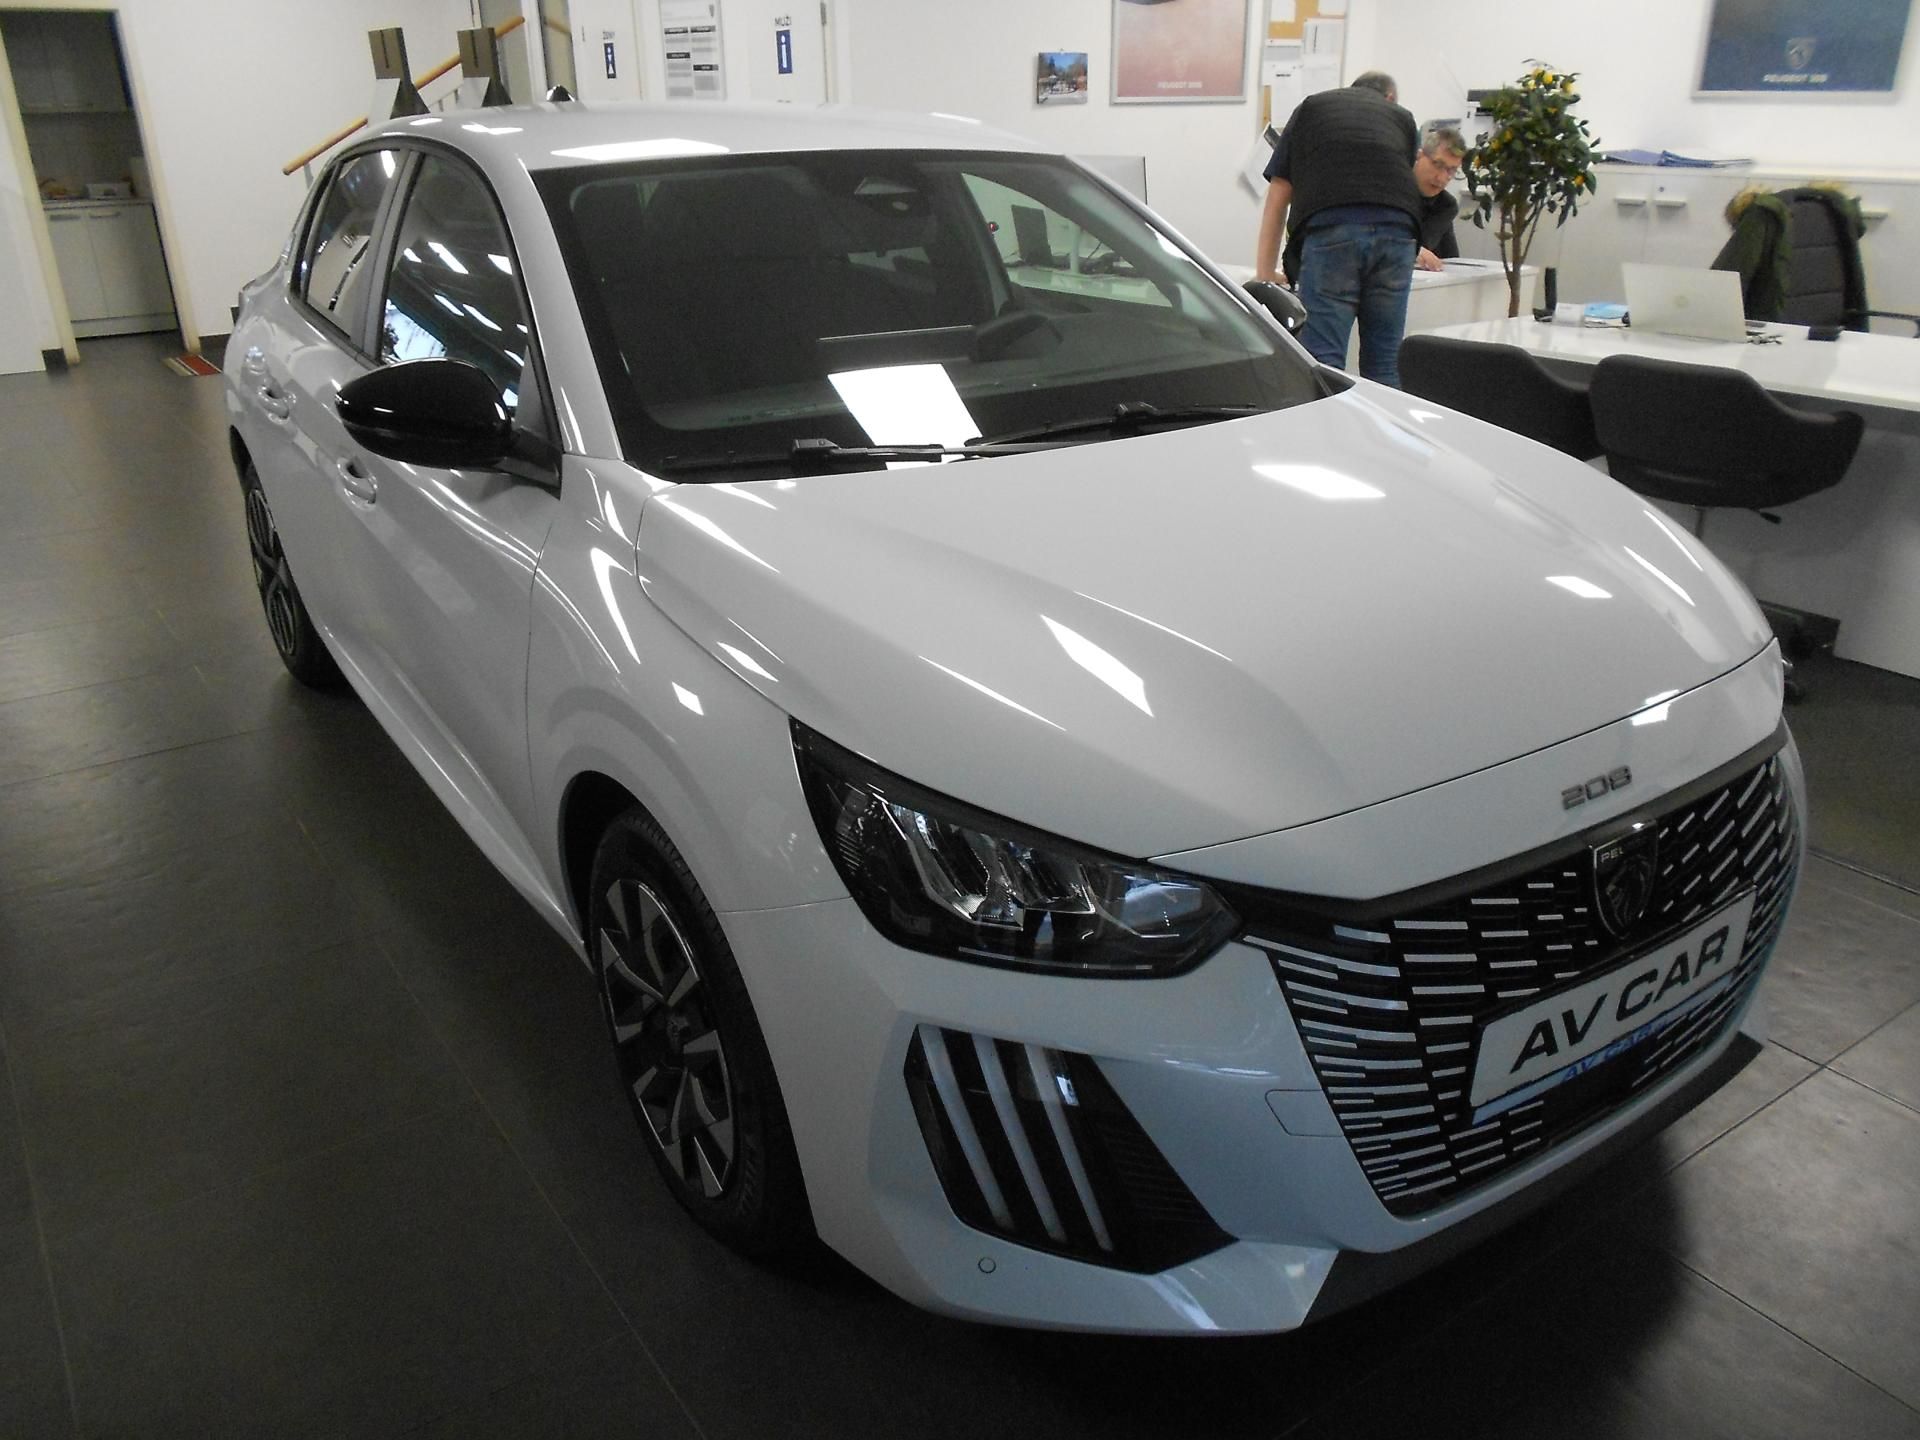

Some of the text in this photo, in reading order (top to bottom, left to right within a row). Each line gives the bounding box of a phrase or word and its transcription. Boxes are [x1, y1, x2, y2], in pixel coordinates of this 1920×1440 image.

[1561, 765, 1632, 810] 208
[1510, 925, 1729, 1074] AV CAR
